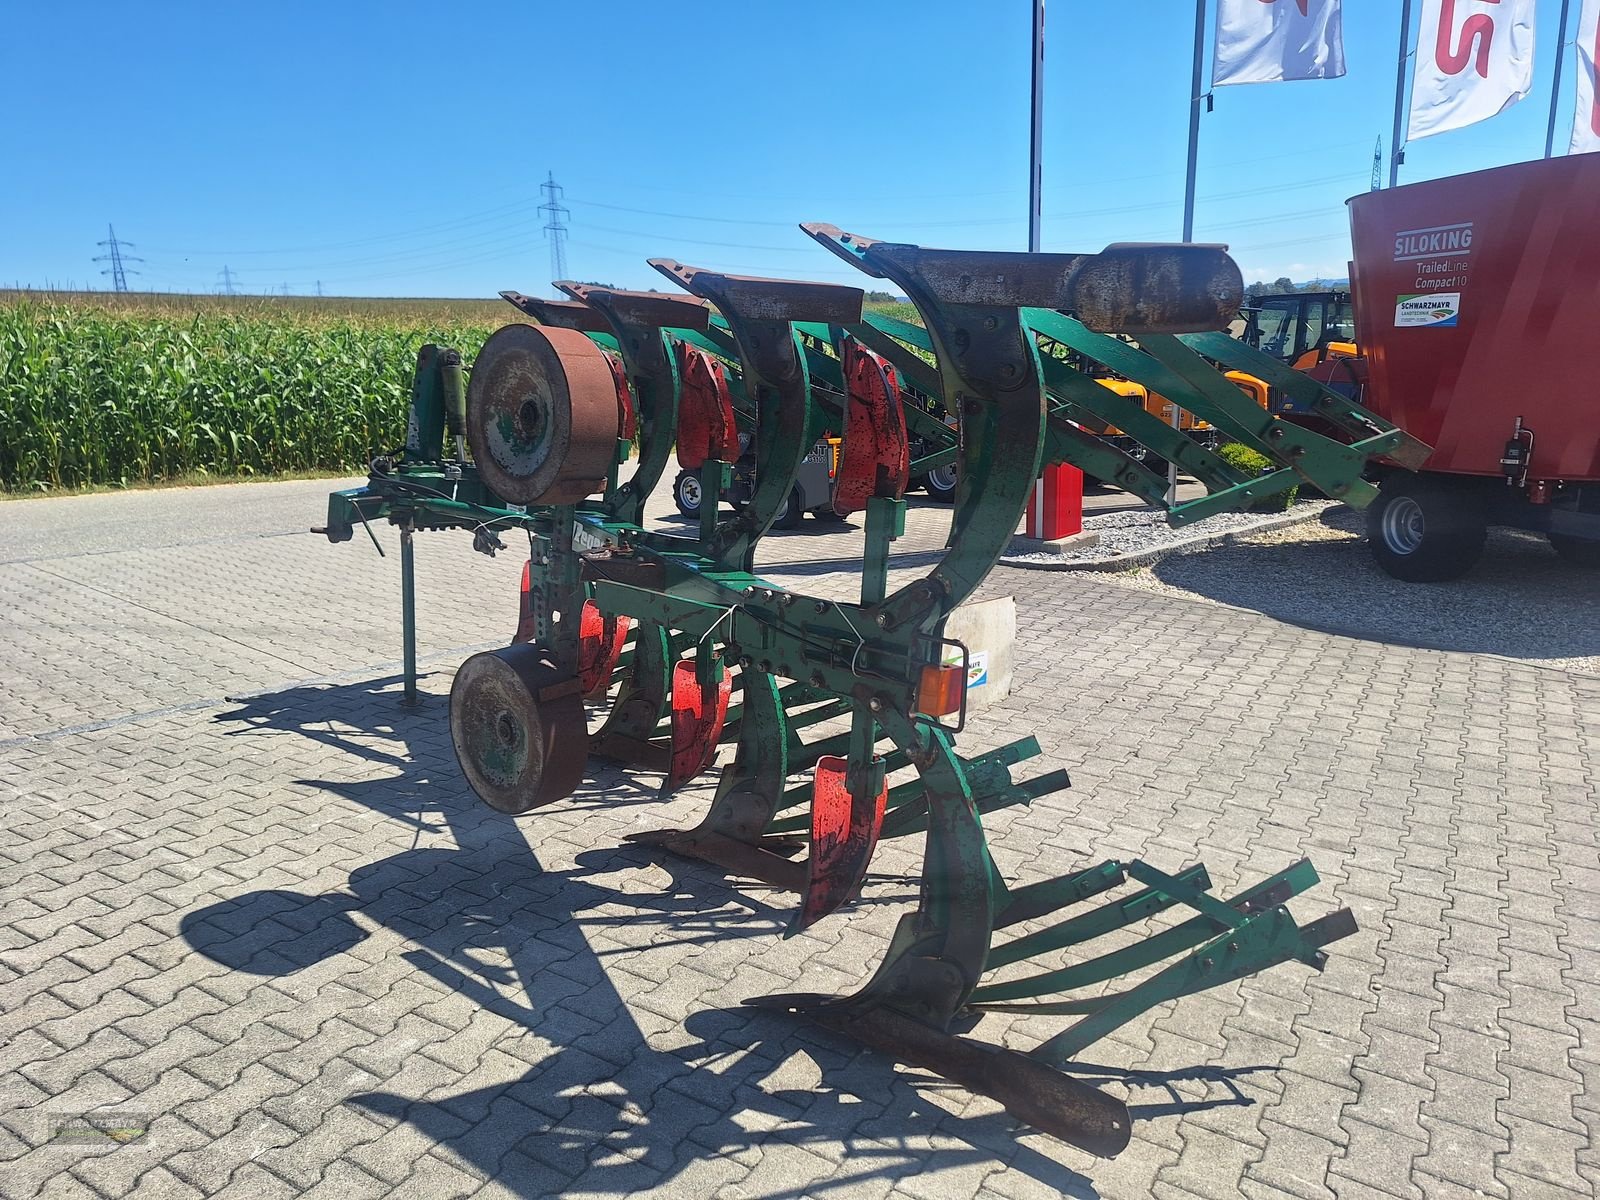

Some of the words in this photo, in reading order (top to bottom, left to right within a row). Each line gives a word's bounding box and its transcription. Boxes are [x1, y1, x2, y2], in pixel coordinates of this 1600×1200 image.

[1394, 229, 1472, 256] SILOKING
[1416, 260, 1468, 274] TrailedLine
[1401, 301, 1450, 309] SCHWARZMAYR
